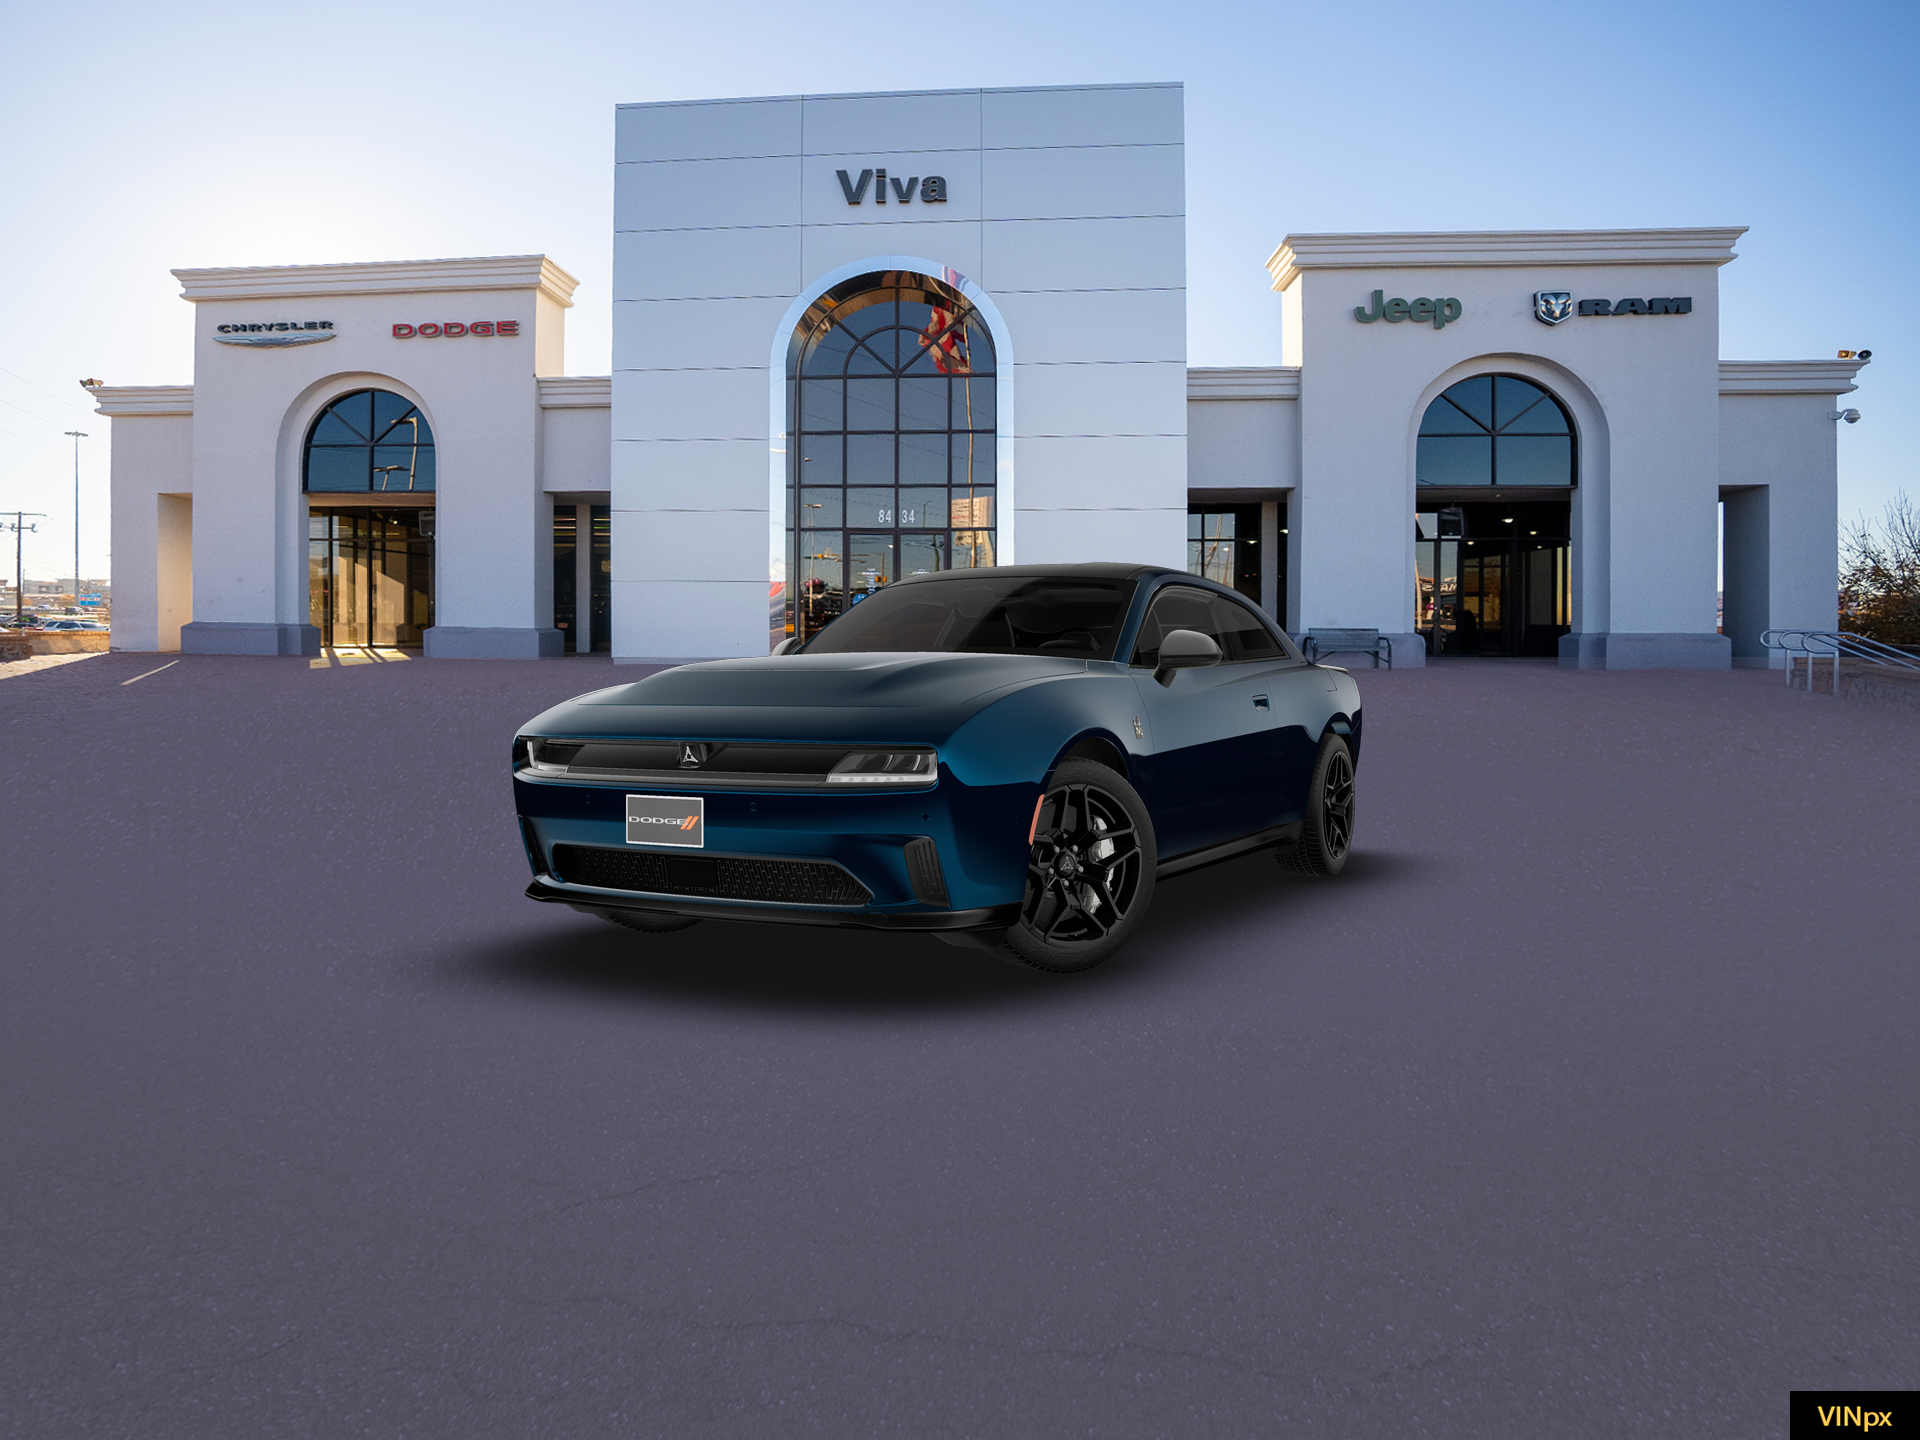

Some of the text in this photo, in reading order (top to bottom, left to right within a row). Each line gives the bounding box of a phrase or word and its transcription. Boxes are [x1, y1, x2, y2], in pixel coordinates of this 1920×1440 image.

[835, 168, 947, 205] Viva
[1354, 289, 1463, 330] Jeep
[1577, 297, 1693, 316] RAM
[217, 320, 334, 334] CHRYSLER
[392, 319, 520, 339] DODGE
[878, 509, 915, 524] 84 34
[628, 815, 689, 826] DODGE
